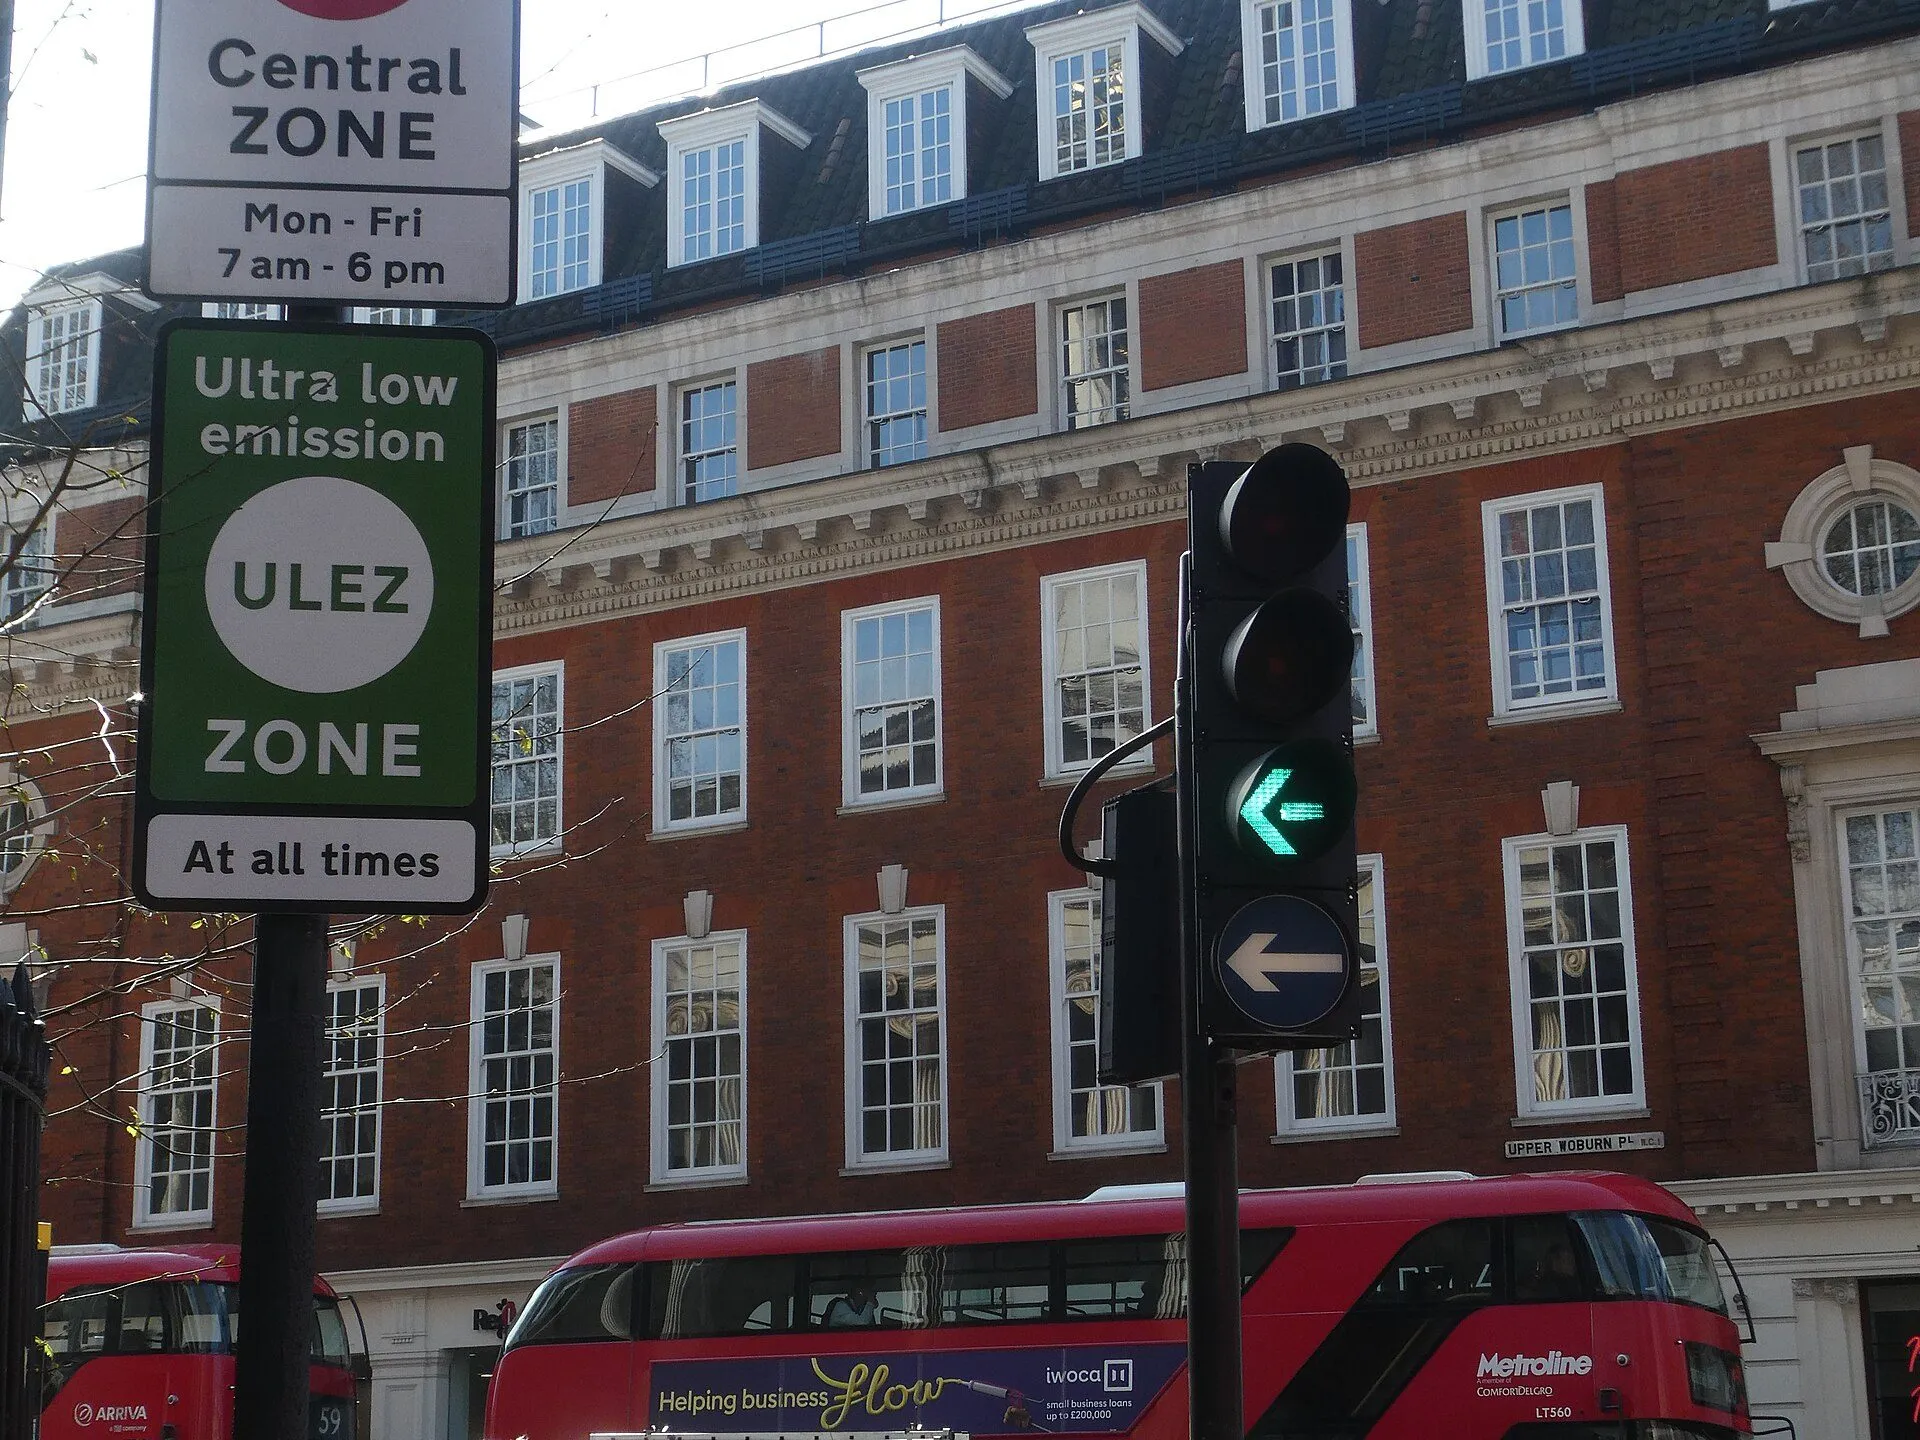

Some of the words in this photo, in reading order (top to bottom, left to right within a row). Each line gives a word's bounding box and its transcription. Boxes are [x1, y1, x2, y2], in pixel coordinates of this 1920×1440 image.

[207, 38, 467, 96] Central
[229, 105, 436, 161] ZONE
[244, 203, 331, 236] Mon
[370, 207, 423, 238] Fri
[195, 356, 339, 403] Ultra
[361, 362, 458, 406] low
[200, 417, 445, 462] emission
[233, 561, 410, 614] ULEZ
[204, 719, 422, 778] ZONE
[183, 840, 234, 874] At
[251, 842, 304, 875] all
[321, 843, 440, 878] times
[1508, 1141, 1552, 1156] UPPER
[1558, 1137, 1612, 1152] WOBURN
[1046, 1367, 1101, 1384] iwoca
[1476, 1350, 1593, 1377] Metroline
[659, 1389, 737, 1415] Helping
[742, 1387, 829, 1409] business
[811, 1358, 944, 1430] flow
[1046, 1400, 1069, 1409] small
[1071, 1399, 1107, 1408] business
[1109, 1399, 1132, 1408] loans
[95, 1405, 147, 1421] ARRIVA
[318, 1407, 341, 1435] 59
[1046, 1414, 1057, 1422] up
[1059, 1412, 1069, 1420] to
[1070, 1410, 1112, 1420] £200,000
[1536, 1407, 1571, 1418] LT560
